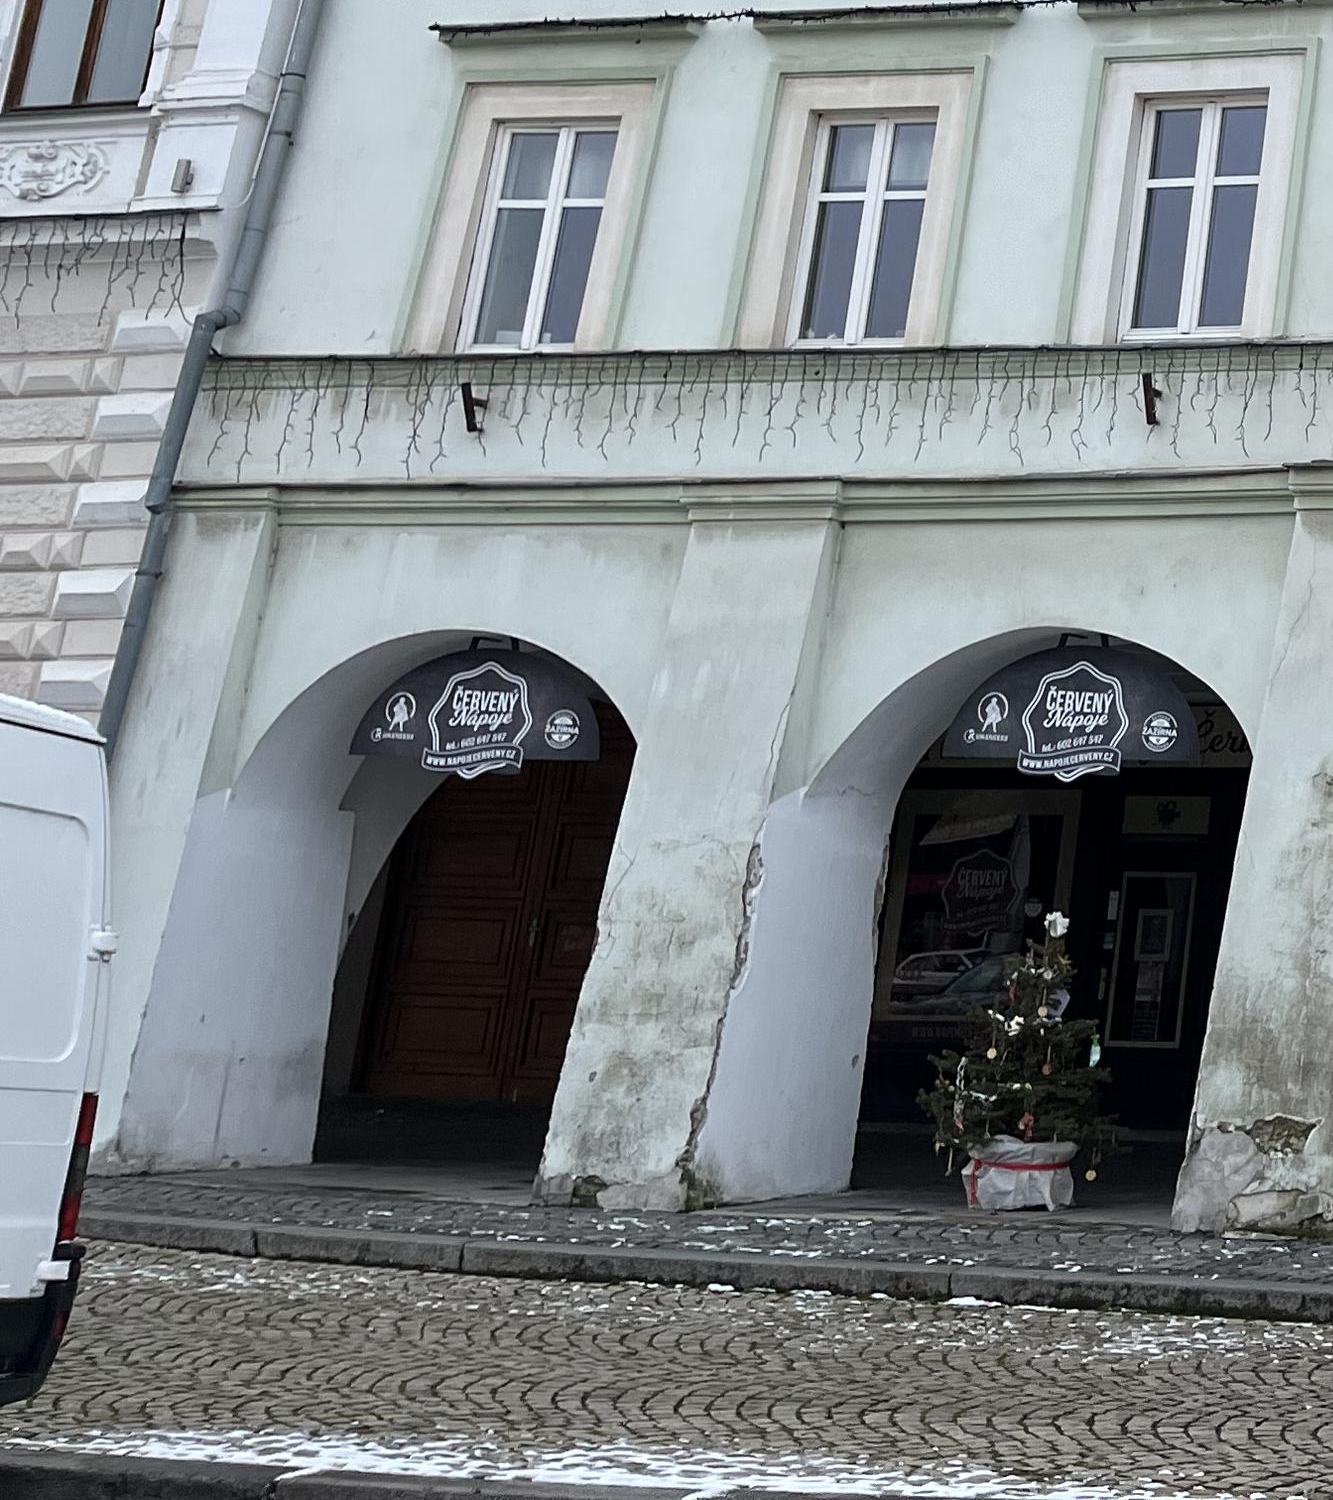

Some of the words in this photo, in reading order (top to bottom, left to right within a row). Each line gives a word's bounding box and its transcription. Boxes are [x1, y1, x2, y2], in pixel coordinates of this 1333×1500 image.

[452, 684, 520, 713] ČERVENÝ
[1046, 685, 1114, 714] ČERVENÝ
[448, 707, 514, 732] Nápoje
[1043, 708, 1109, 733] Nápoje
